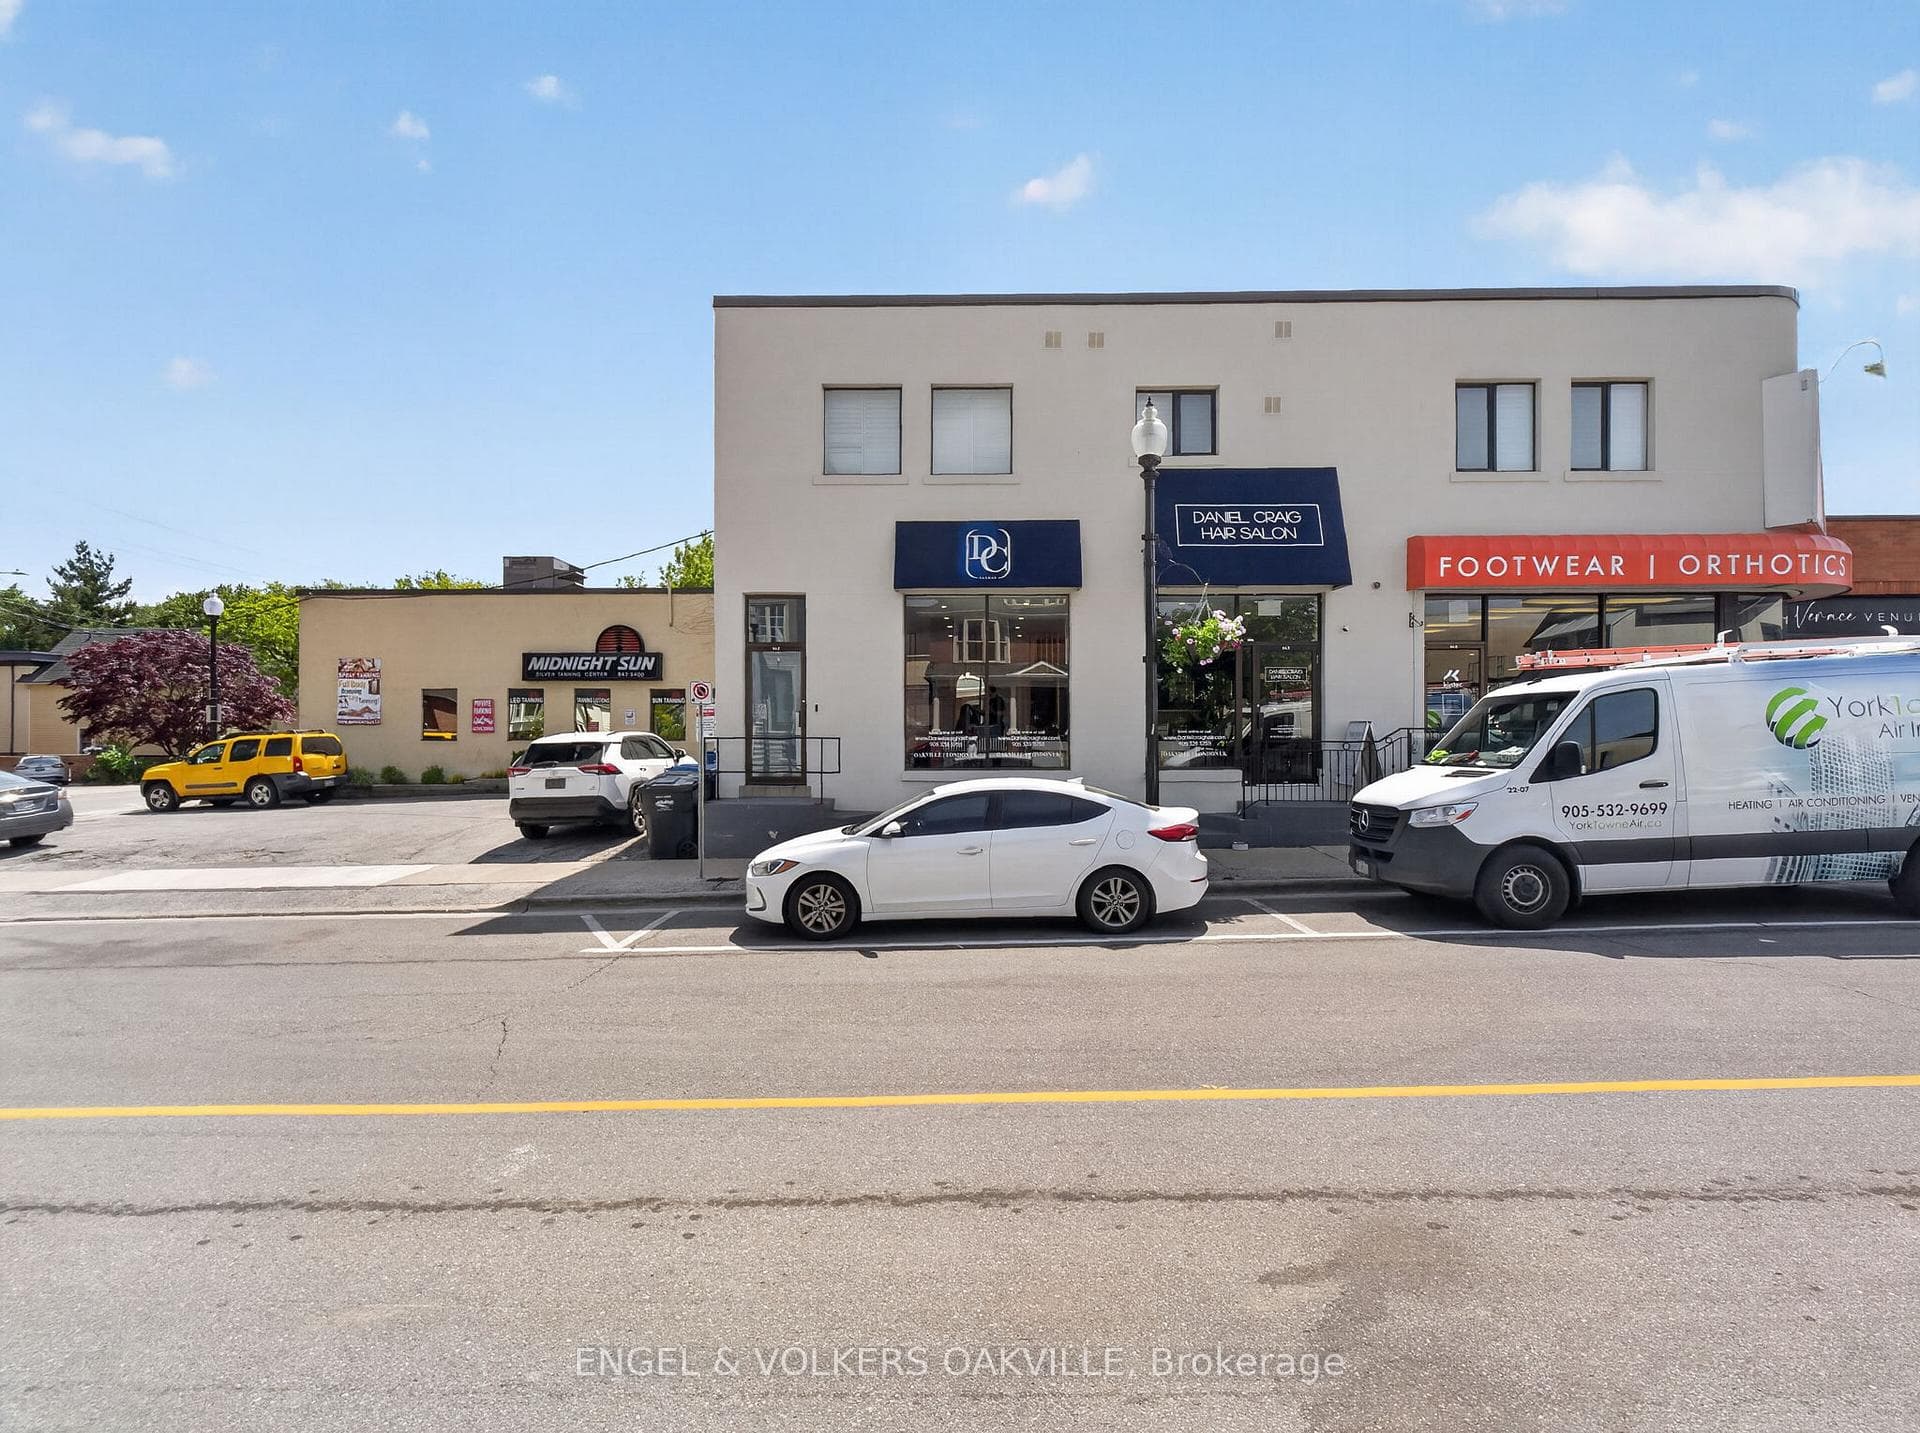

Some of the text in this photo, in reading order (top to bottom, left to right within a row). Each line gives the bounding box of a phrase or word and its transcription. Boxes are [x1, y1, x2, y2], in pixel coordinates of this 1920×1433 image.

[1193, 511, 1302, 524] DANIEL CRAIG
[1201, 527, 1297, 540] HAIR SALON
[1439, 555, 1625, 578] FOOTWEAR
[1678, 553, 1847, 577] ORTHOTICS
[1864, 612, 1920, 622] VENU
[528, 656, 655, 671] MIDNIGHT SUN
[1879, 721, 1905, 738] Air
[1728, 800, 1773, 810] HEATING
[1788, 799, 1804, 808] AIR
[1807, 794, 1886, 807] CONDITIONING
[1562, 802, 1668, 818] 905-532-9699
